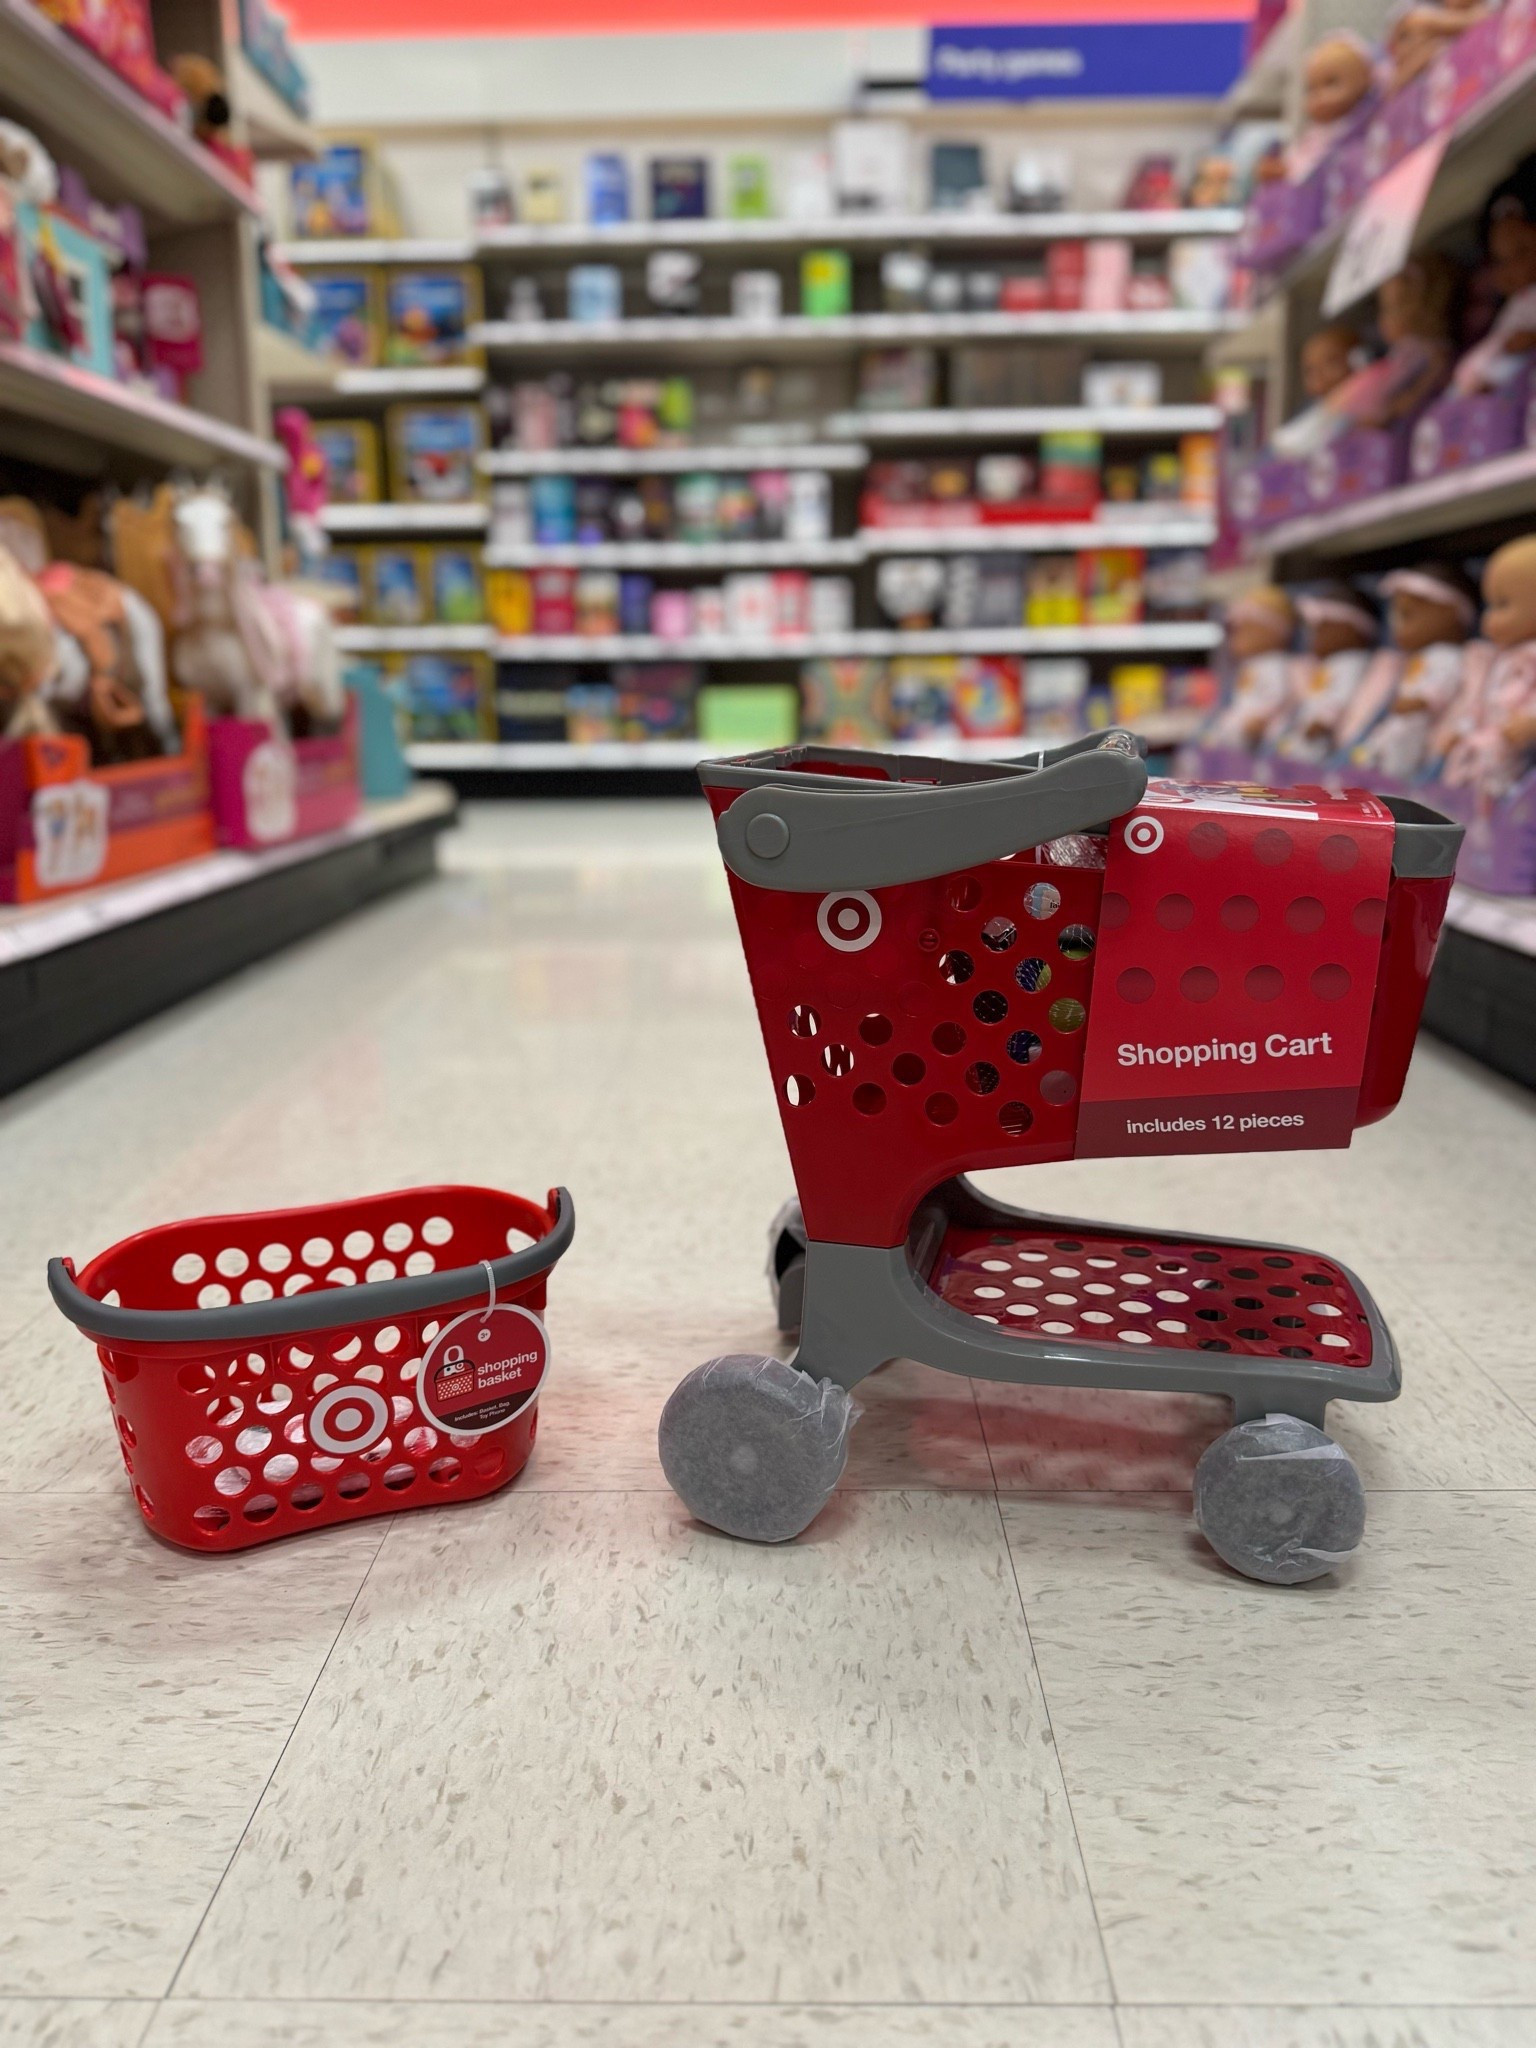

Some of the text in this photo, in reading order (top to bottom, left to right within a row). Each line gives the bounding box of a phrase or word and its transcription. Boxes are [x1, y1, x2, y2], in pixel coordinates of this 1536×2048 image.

[1117, 1032, 1333, 1068] Shopping Cart
[1126, 1113, 1305, 1134] includes 12 pieces
[477, 1351, 538, 1376] shopping
[478, 1368, 522, 1389] basket
[454, 1410, 478, 1422] Includes:
